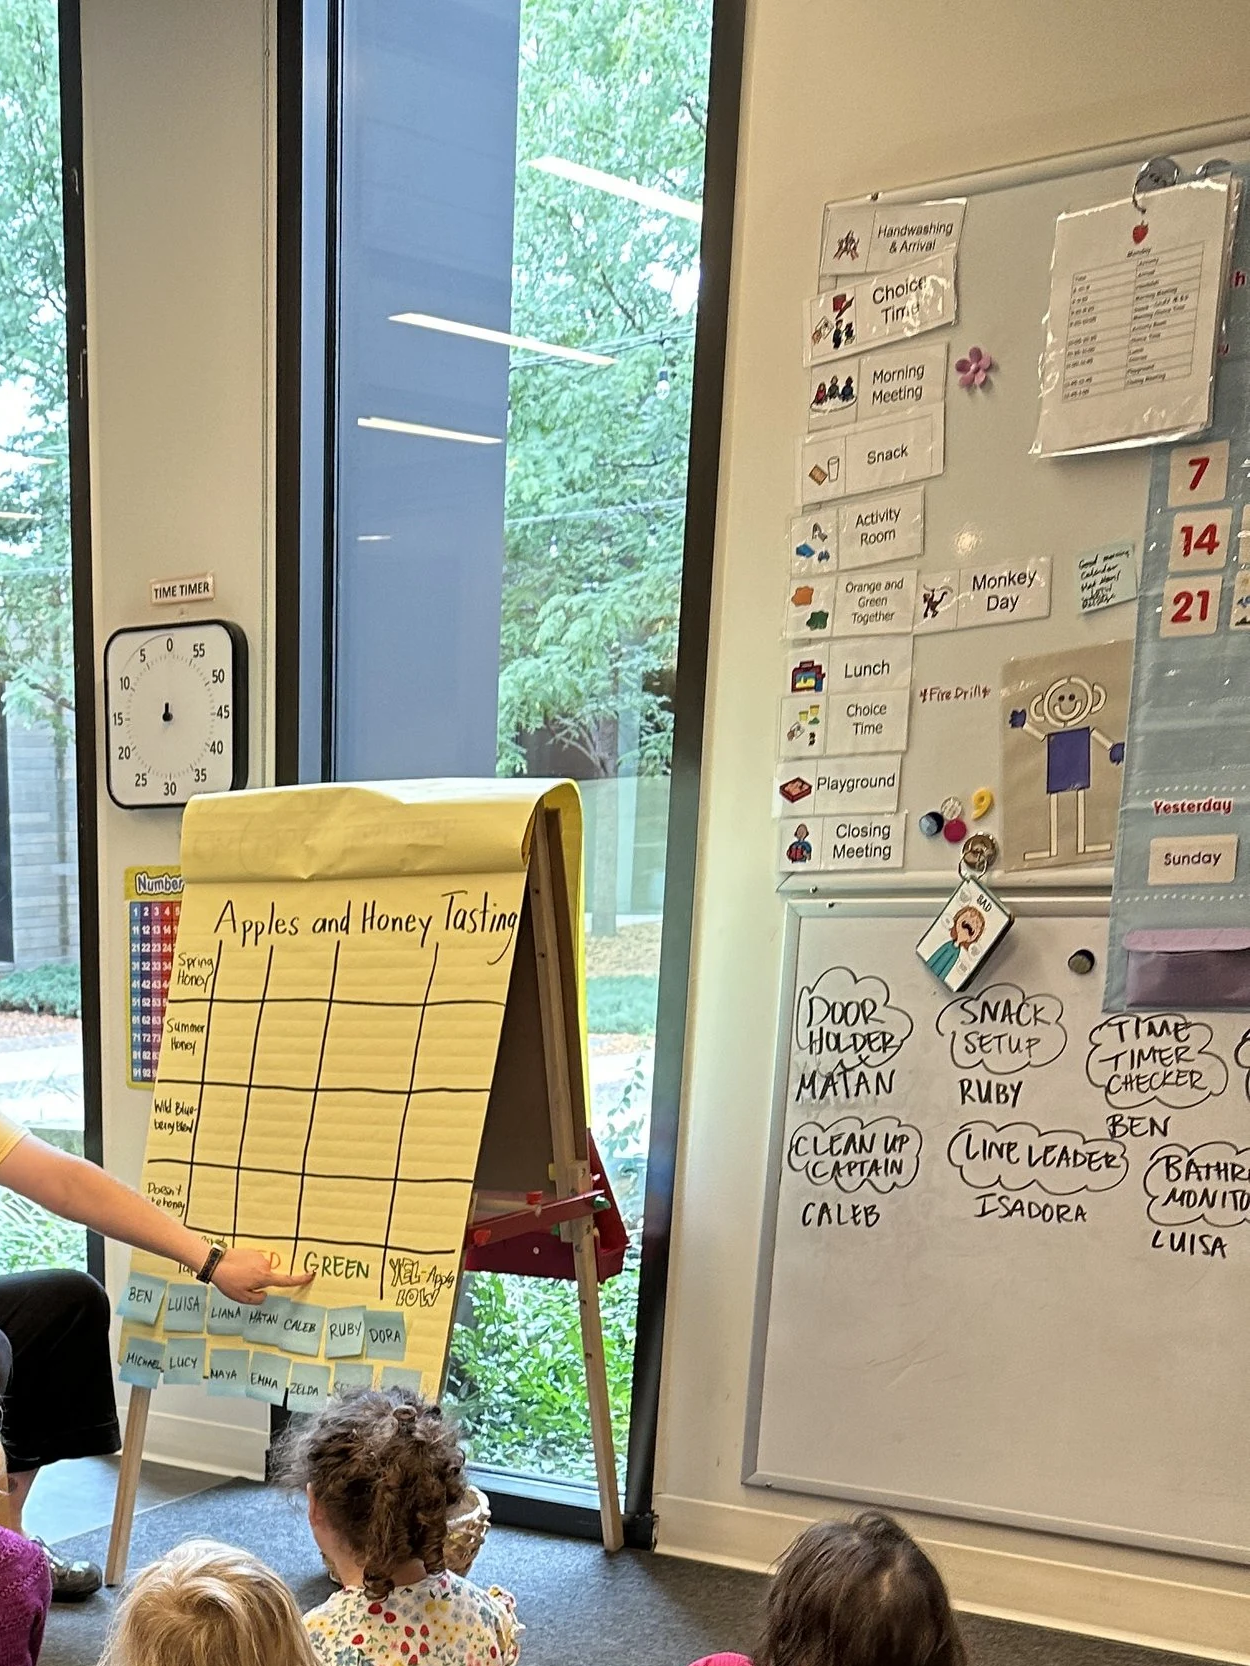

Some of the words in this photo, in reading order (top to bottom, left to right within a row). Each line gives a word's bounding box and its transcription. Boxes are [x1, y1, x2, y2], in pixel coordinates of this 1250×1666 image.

[877, 222, 954, 239] Handwashing
[889, 241, 897, 254] &
[900, 238, 936, 252] Arrival
[872, 275, 926, 305] Choice
[881, 301, 920, 325] Time
[873, 364, 925, 385] Morning
[872, 385, 923, 405] Meeting
[867, 444, 909, 465] Snack
[1188, 456, 1210, 491] 7
[855, 508, 901, 528] Activity
[860, 529, 896, 547] Room
[1180, 523, 1220, 558] 14
[845, 581, 882, 594] Orange
[884, 577, 904, 590] and
[972, 569, 1037, 592] Monkey
[153, 584, 177, 600] TIME
[179, 581, 210, 597] TIMER
[858, 596, 888, 608] Green
[986, 594, 1020, 613] Day
[1170, 589, 1210, 623] 21
[851, 610, 895, 626] Together
[166, 637, 174, 652] 0
[192, 643, 205, 658] 55
[139, 649, 146, 664] 5
[212, 669, 225, 683] 50
[844, 659, 890, 679] Lunch
[120, 676, 130, 691] 10
[113, 712, 124, 726] 15
[217, 705, 230, 719] 45
[846, 703, 887, 718] Choice
[852, 721, 883, 736] Time
[118, 746, 130, 760] 20
[209, 741, 224, 755] 40
[134, 773, 148, 787] 25
[194, 768, 207, 783] 35
[816, 773, 896, 794] Playground
[163, 782, 177, 797] 30
[1153, 797, 1233, 816] Yesterday
[835, 822, 891, 840] Closing
[832, 843, 892, 861] Meeting
[1163, 850, 1222, 867] Sunday
[134, 907, 138, 917] 1
[143, 907, 149, 917] 2
[154, 907, 160, 917] 3
[164, 907, 170, 917] 4
[976, 893, 993, 913] BAD
[132, 925, 139, 935] 11
[142, 925, 151, 935] 12
[152, 925, 161, 935] 13
[163, 925, 171, 935] 14
[213, 899, 300, 948] Apples
[311, 899, 352, 935] and
[361, 900, 433, 948] Honey
[440, 889, 518, 965] Tasting
[132, 943, 140, 952] 21
[141, 943, 151, 952] 22
[152, 943, 161, 952] 23
[162, 943, 172, 952] 24
[132, 962, 140, 971] 31
[141, 962, 151, 971] 32
[152, 962, 161, 971] 33
[178, 952, 214, 974] Spring
[132, 980, 140, 989] 41
[141, 980, 151, 989] 42
[152, 980, 161, 989] 43
[177, 969, 210, 993] Honey
[142, 1016, 151, 1025] 62
[806, 995, 886, 1028] DOOR
[960, 998, 1052, 1026] SNACK
[166, 1017, 205, 1033] Summer
[1107, 1017, 1192, 1044] TIME
[132, 1033, 140, 1043] 71
[142, 1033, 151, 1043] 72
[152, 1033, 161, 1043] 73
[170, 1036, 197, 1056] Honey
[808, 1026, 902, 1055] HOLDER
[963, 1031, 1041, 1058] SETUP
[1099, 1045, 1196, 1072] TIMER
[142, 1068, 151, 1078] 92
[1106, 1069, 1208, 1095] CHECKER
[796, 1068, 896, 1101] MATAN
[959, 1078, 1023, 1108] RUBY
[154, 1097, 172, 1114] Wild
[1106, 1113, 1172, 1139] BEN
[795, 1132, 877, 1157] CLEAN
[884, 1132, 910, 1155] UP
[965, 1133, 1020, 1165] LINE
[1027, 1143, 1123, 1172] LEADER
[811, 1158, 903, 1178] CAPTAIN
[1163, 1154, 1250, 1183] BATHR
[802, 1202, 881, 1228] CALEB
[974, 1193, 1088, 1223] ISADORA
[1151, 1229, 1228, 1258] LUISA
[303, 1251, 370, 1279] GREEN
[128, 1286, 153, 1304] BEN
[167, 1295, 200, 1312] LUISA
[211, 1306, 242, 1320] LIANA
[248, 1311, 279, 1325] MATAN
[283, 1318, 317, 1333] CALEB
[329, 1321, 363, 1340] RUBY
[369, 1328, 401, 1344] DORA
[126, 1352, 162, 1371] MICHAEL
[169, 1357, 198, 1370] LUCY
[210, 1369, 238, 1380] MAYA
[250, 1372, 278, 1389] EMMA
[289, 1382, 319, 1396] ZELDA
